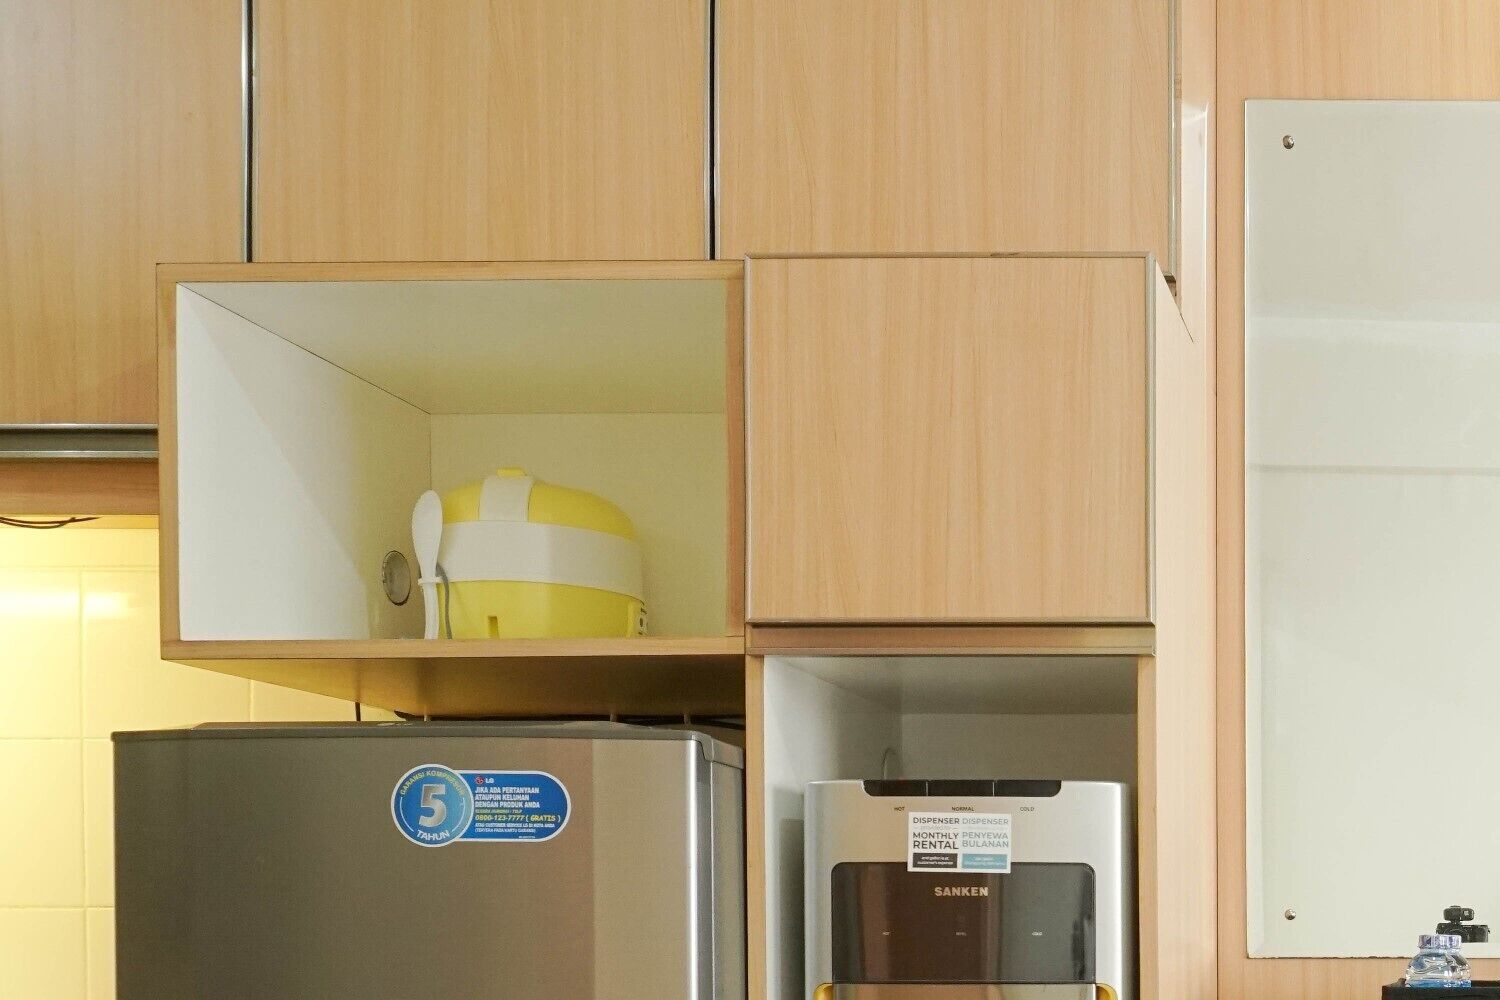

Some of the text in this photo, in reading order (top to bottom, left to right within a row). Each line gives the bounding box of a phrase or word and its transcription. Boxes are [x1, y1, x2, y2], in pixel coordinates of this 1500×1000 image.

[419, 784, 447, 827] 5
[416, 829, 450, 841] TAHUN
[913, 832, 959, 840] MONTHLY
[962, 832, 1008, 840] PENYEWA
[913, 841, 959, 850] RENTAL
[962, 840, 1009, 848] BULANAN
[934, 886, 989, 897] SANKEN
